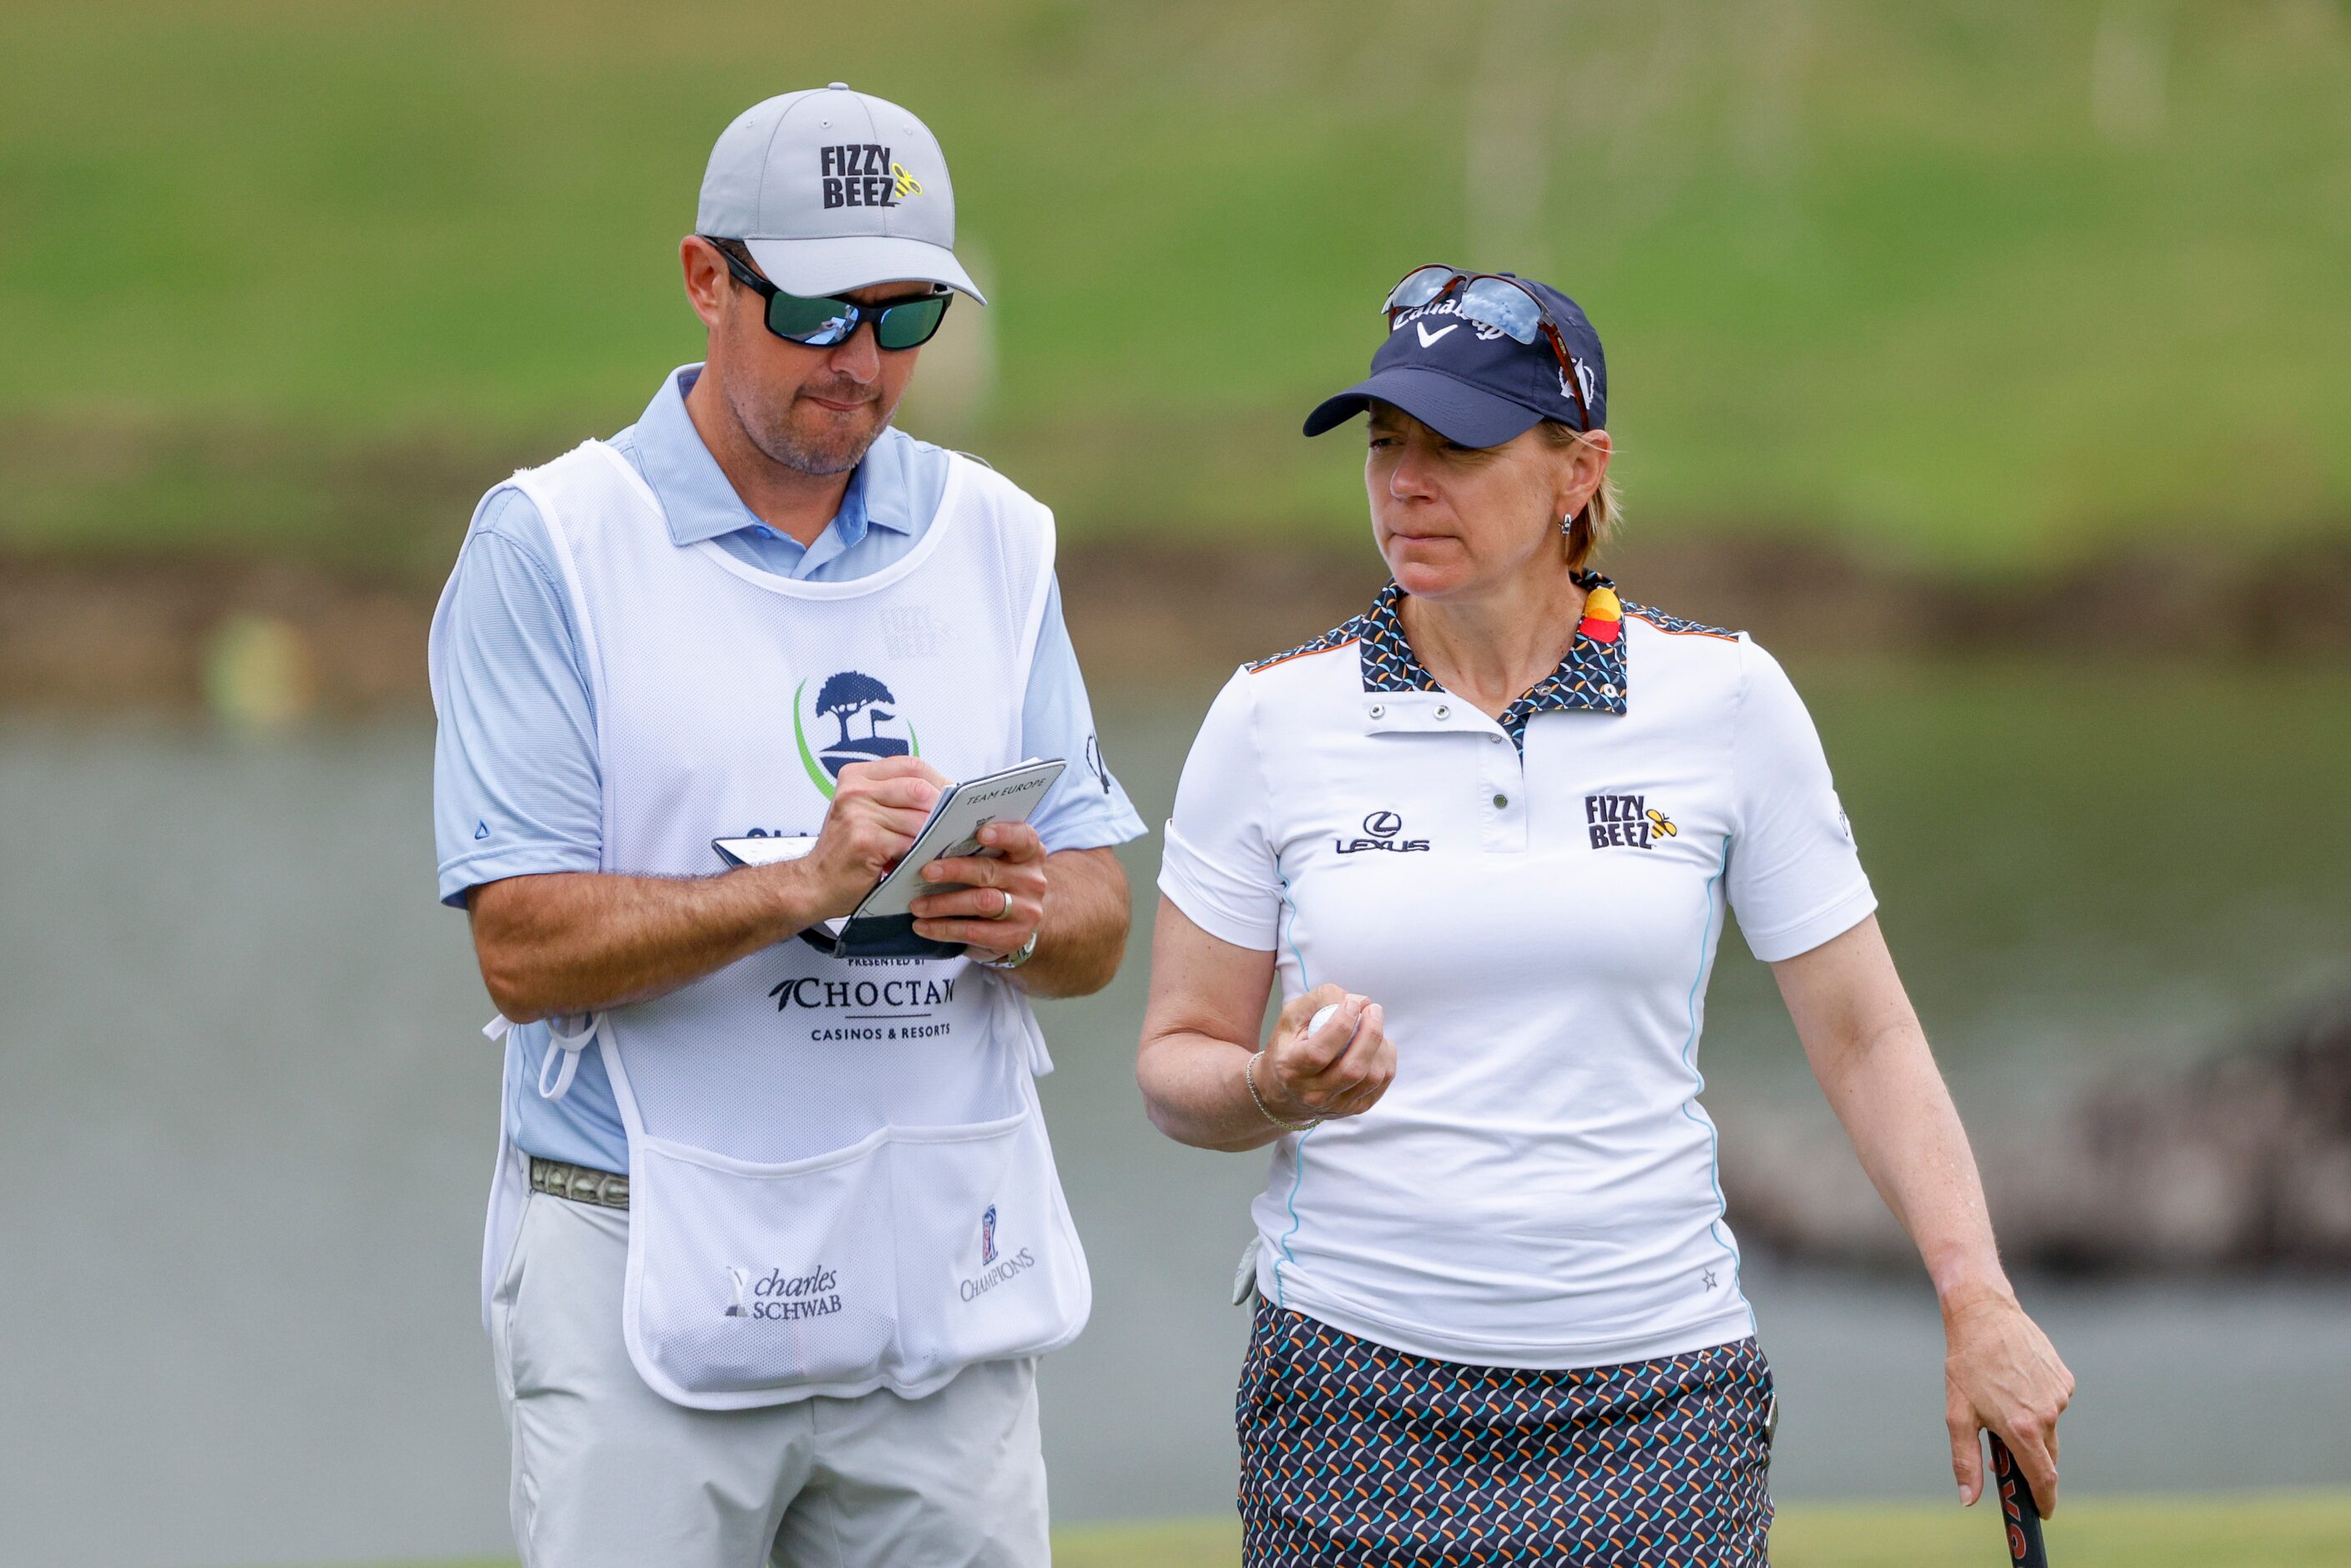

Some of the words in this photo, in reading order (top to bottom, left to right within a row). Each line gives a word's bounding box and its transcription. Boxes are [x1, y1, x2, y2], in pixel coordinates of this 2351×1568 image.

[821, 144, 891, 176] FIZZY
[823, 177, 896, 209] BEEZ
[966, 789, 1000, 806] TEAM
[1000, 777, 1047, 797] EUROPE
[1585, 794, 1645, 824] FIZZY
[1336, 838, 1430, 854] LEXUS
[1588, 822, 1652, 850] BEEZ
[848, 959, 910, 967] PRESENTED
[811, 1029, 882, 1041] CASINOS
[887, 1029, 897, 1040] &
[901, 1023, 951, 1039] RESORTS
[753, 1264, 837, 1297] charles
[959, 1247, 1036, 1302] CHAMPIONS
[752, 1294, 843, 1321] SCHWAB
